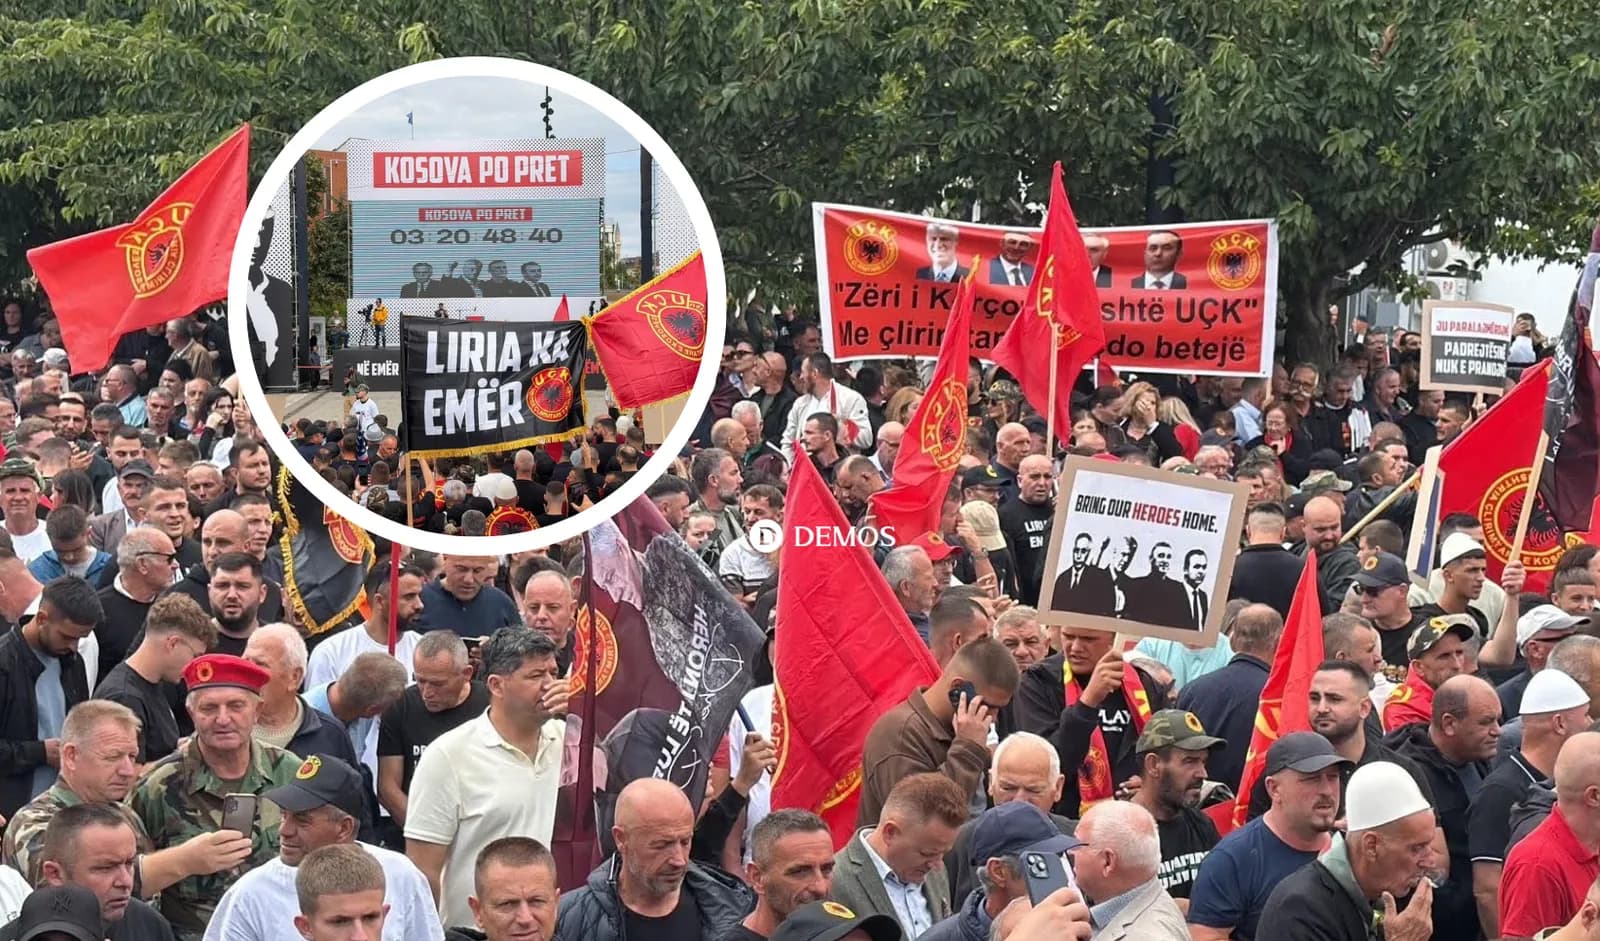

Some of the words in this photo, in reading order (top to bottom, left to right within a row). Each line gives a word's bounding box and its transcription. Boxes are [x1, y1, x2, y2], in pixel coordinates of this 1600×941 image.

[384, 155, 473, 184] KOSOVA
[479, 155, 509, 184] PO
[514, 154, 570, 183] PRET
[424, 208, 473, 222] KOSOVA
[476, 208, 493, 221] PO
[495, 207, 526, 221] PRET
[835, 281, 900, 308] "Zëri
[911, 284, 918, 309] i
[1100, 295, 1166, 323] shtë
[1175, 297, 1258, 330] UÇK"
[1436, 319, 1448, 332] JU
[425, 329, 522, 374] LIRIA
[528, 329, 571, 368] KA
[839, 320, 869, 346] Me
[1102, 334, 1145, 357] do
[1155, 335, 1246, 368] betejë
[371, 359, 400, 376] EMËR
[1435, 358, 1459, 374] NUK
[1459, 359, 1467, 374] E
[423, 377, 526, 436] EMËR
[1074, 494, 1107, 515] BRING
[1107, 498, 1132, 519] OUR
[1131, 502, 1182, 527] HEROES
[1181, 510, 1219, 534] HOME.
